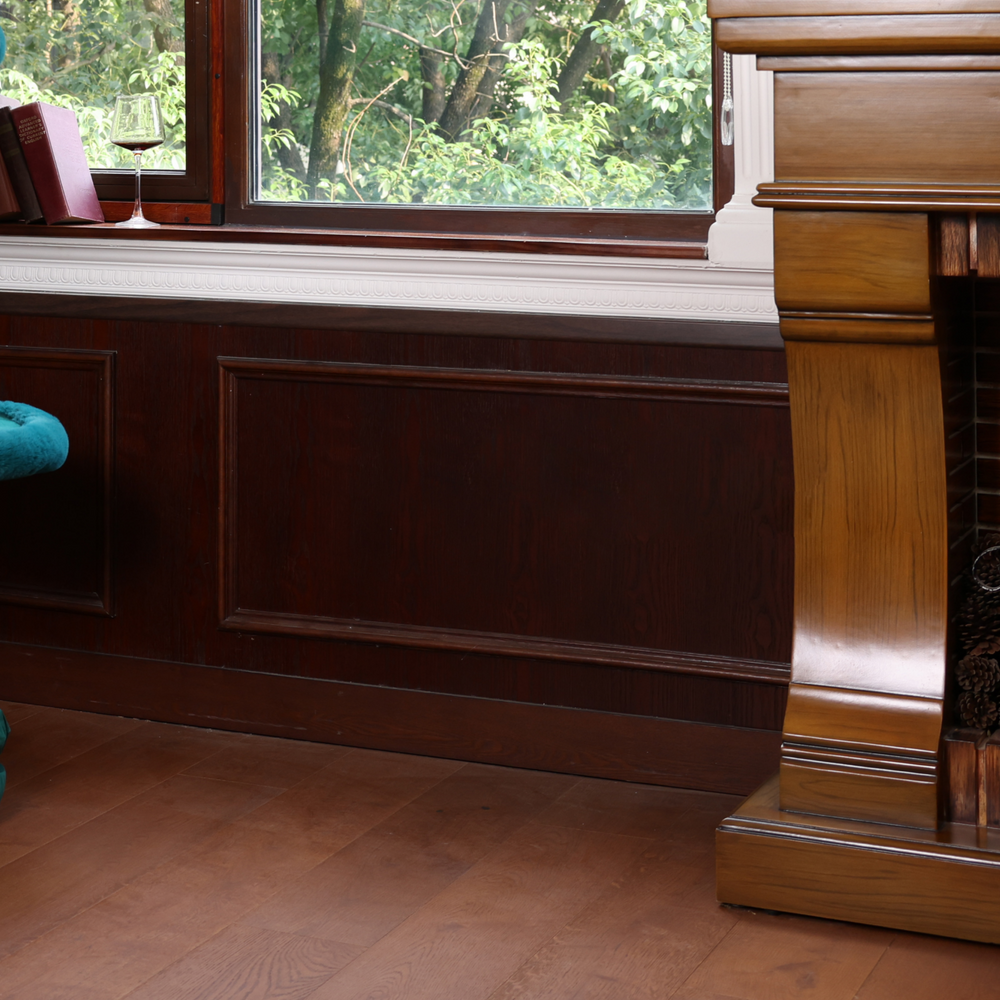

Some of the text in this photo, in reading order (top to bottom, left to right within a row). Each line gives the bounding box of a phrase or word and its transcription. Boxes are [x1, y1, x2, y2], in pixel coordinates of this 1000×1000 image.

[19, 118, 42, 129] ADVANCED
[20, 122, 43, 134] LEARNER'S
[19, 126, 44, 138] DICTIONARY
